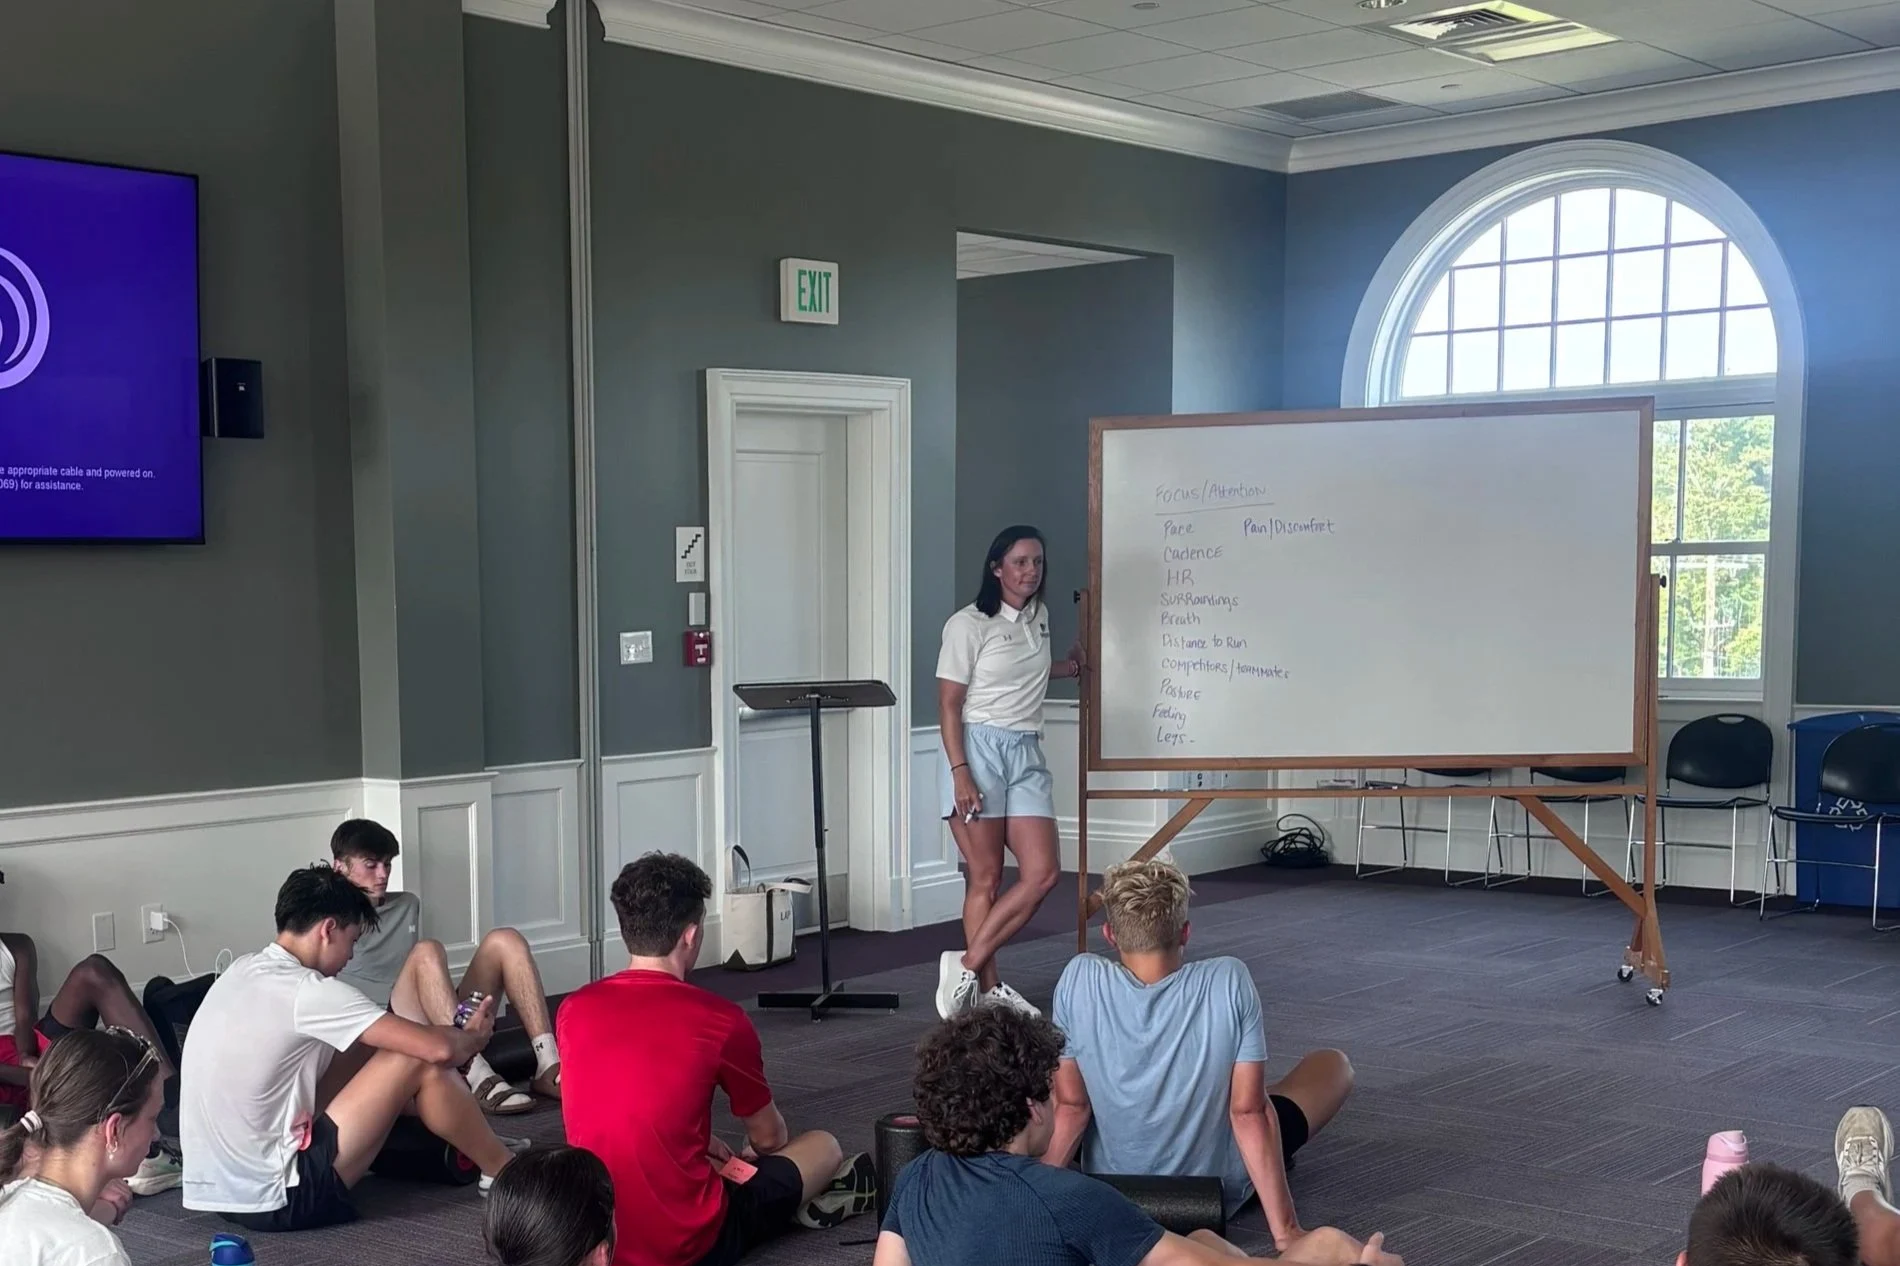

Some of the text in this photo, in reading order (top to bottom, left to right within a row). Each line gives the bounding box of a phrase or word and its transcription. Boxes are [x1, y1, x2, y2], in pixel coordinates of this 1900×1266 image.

[798, 269, 831, 314] EXIT
[8, 465, 58, 478] appropriate
[60, 466, 84, 477] cable
[86, 467, 102, 477] and
[104, 467, 140, 479] powered
[20, 479, 33, 490] for
[35, 480, 84, 491] assistance.
[1164, 519, 1195, 540] Pace
[1167, 568, 1194, 587] HR
[1161, 611, 1201, 625] Breath
[1213, 634, 1223, 648] to
[1227, 636, 1248, 649] Run
